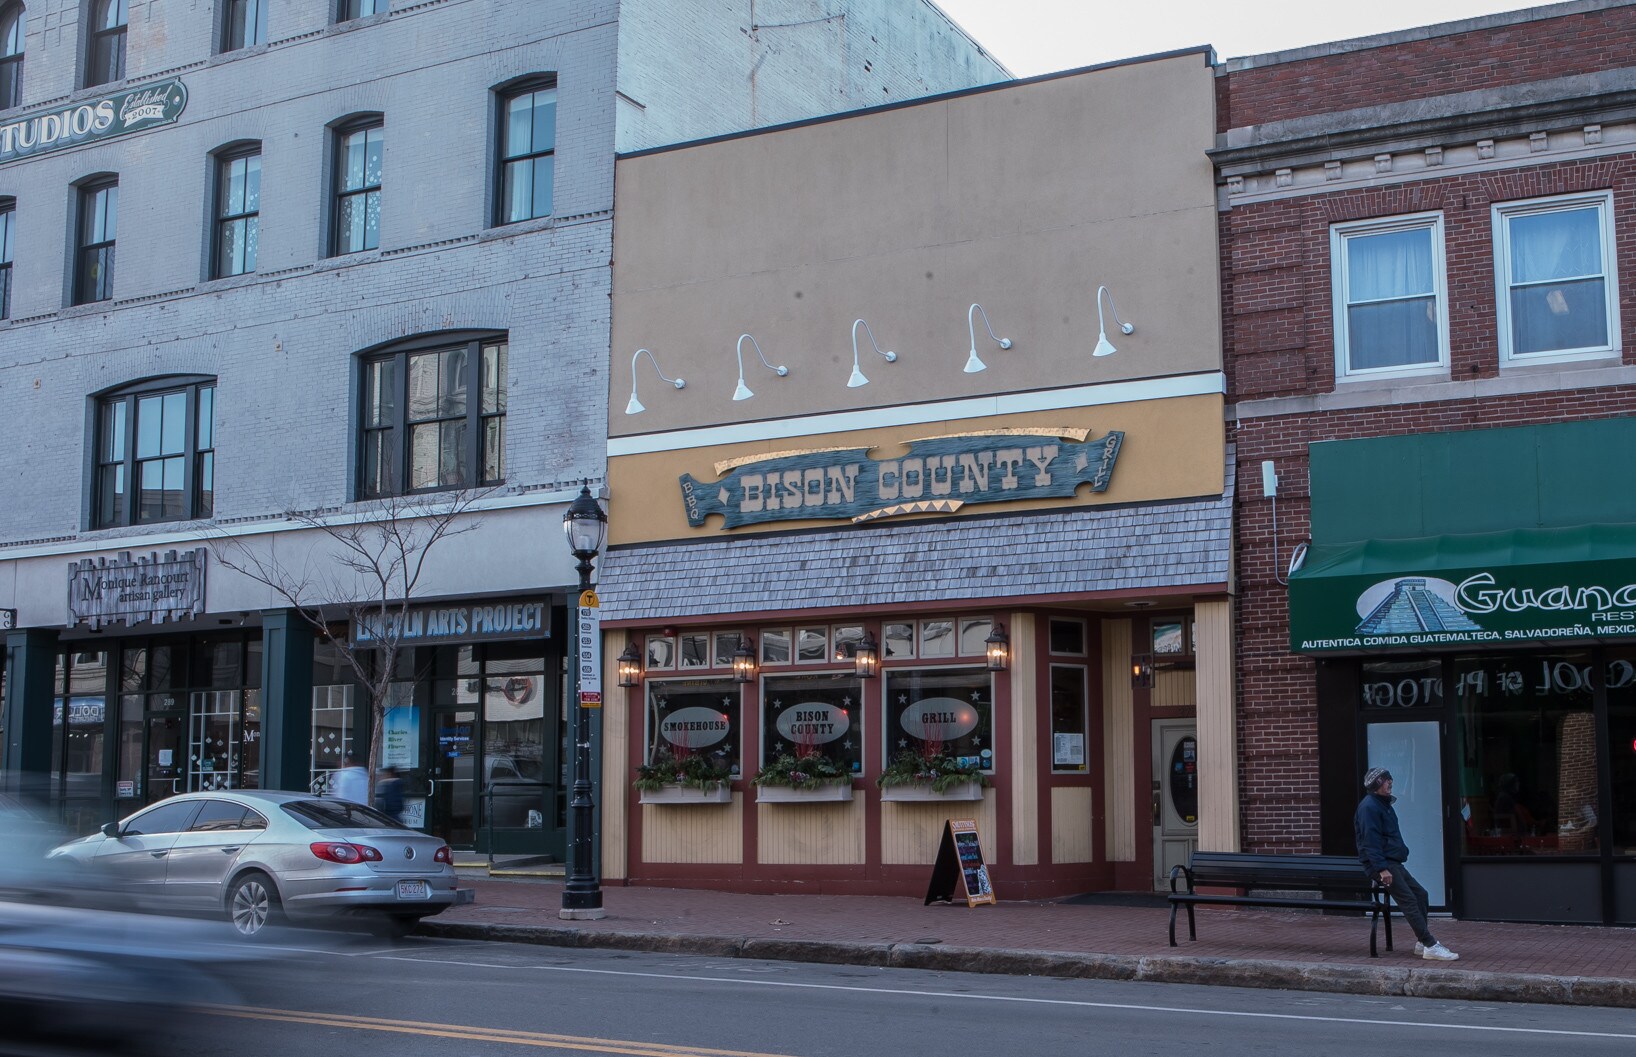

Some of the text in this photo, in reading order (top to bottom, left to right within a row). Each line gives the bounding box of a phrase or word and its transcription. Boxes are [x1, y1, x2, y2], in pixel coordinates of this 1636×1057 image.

[120, 84, 174, 119] Established
[131, 108, 158, 120] 2007
[1094, 435, 1117, 487] GRILL
[739, 445, 1058, 513] BISON COUNTY
[82, 571, 189, 601] Monique Rancourt
[119, 586, 186, 604] artisan gallery
[427, 608, 468, 636] ARTS
[471, 602, 544, 634] PROJECT
[1301, 636, 1361, 648] AUTENTICA
[1363, 634, 1408, 646] COMIDA
[1410, 630, 1502, 644] GUATEMALTECA,
[1504, 624, 1594, 640] SALVADOREÑA,
[664, 721, 726, 731] SMOKEHOUSE
[796, 710, 829, 722] BISON
[922, 712, 956, 724] GRILL
[791, 724, 834, 734] COUNTY
